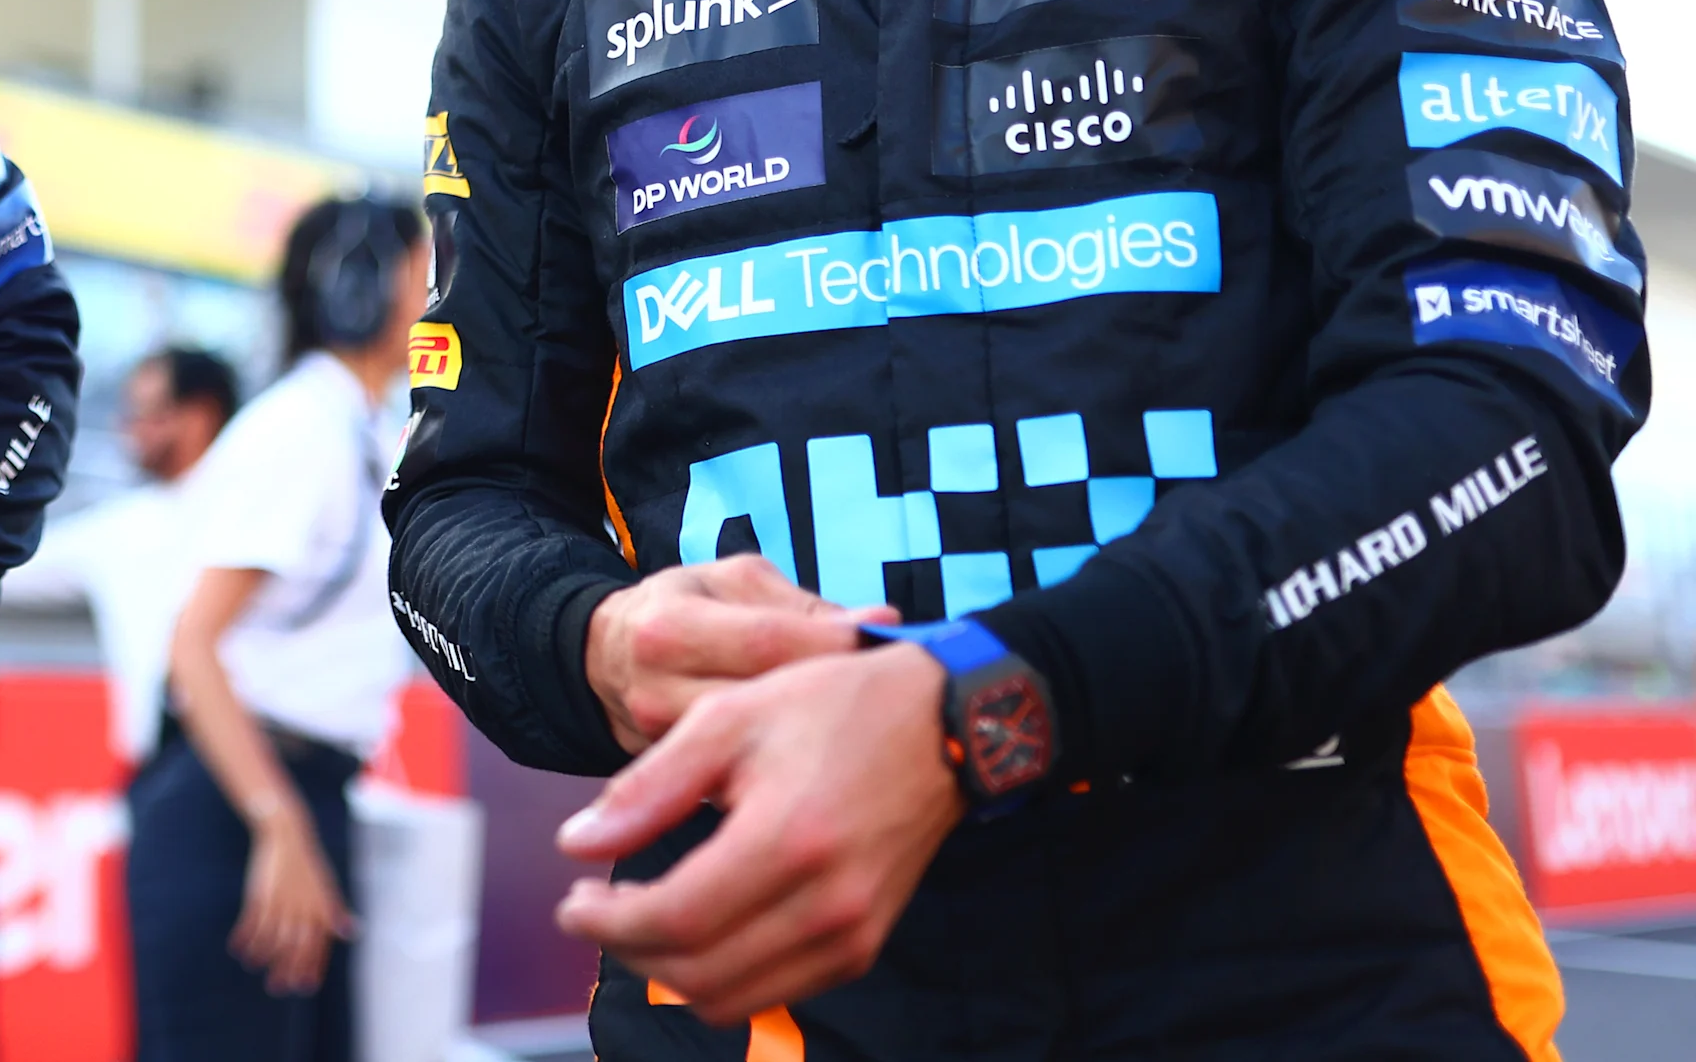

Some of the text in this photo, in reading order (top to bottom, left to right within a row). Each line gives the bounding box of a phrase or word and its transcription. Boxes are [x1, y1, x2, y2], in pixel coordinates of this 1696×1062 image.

[1420, 70, 1609, 152] alteryx
[633, 157, 790, 215] DP WORLD
[1428, 175, 1616, 262] vmware
[635, 215, 1198, 344] DELL Technologies
[1461, 286, 1618, 384] smartsheet
[1259, 435, 1548, 632] ICHARD MILLE
